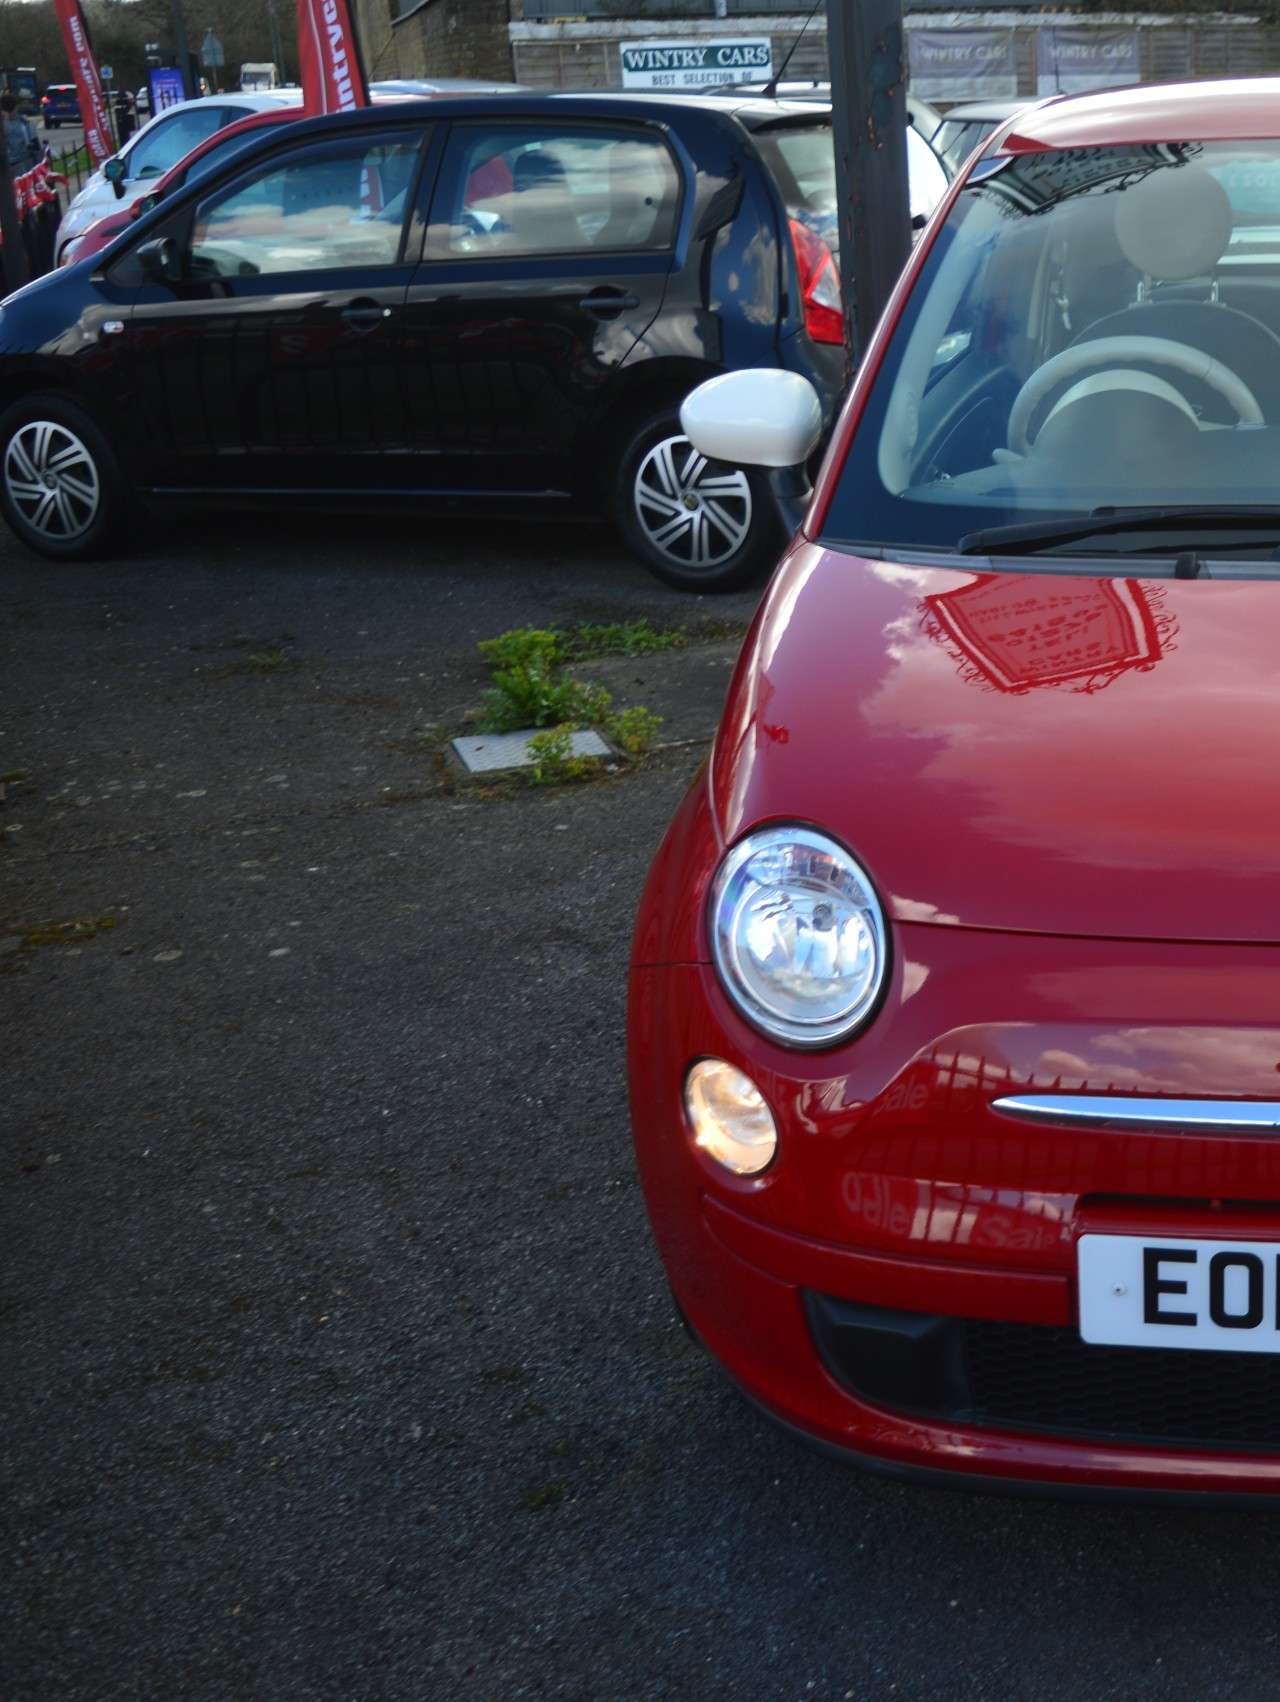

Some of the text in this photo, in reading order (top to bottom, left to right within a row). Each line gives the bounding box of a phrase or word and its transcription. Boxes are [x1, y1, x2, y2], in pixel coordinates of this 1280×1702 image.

[625, 46, 769, 69] WINTRY CARS
[652, 74, 676, 86] BEST
[683, 72, 735, 85] SELECTION
